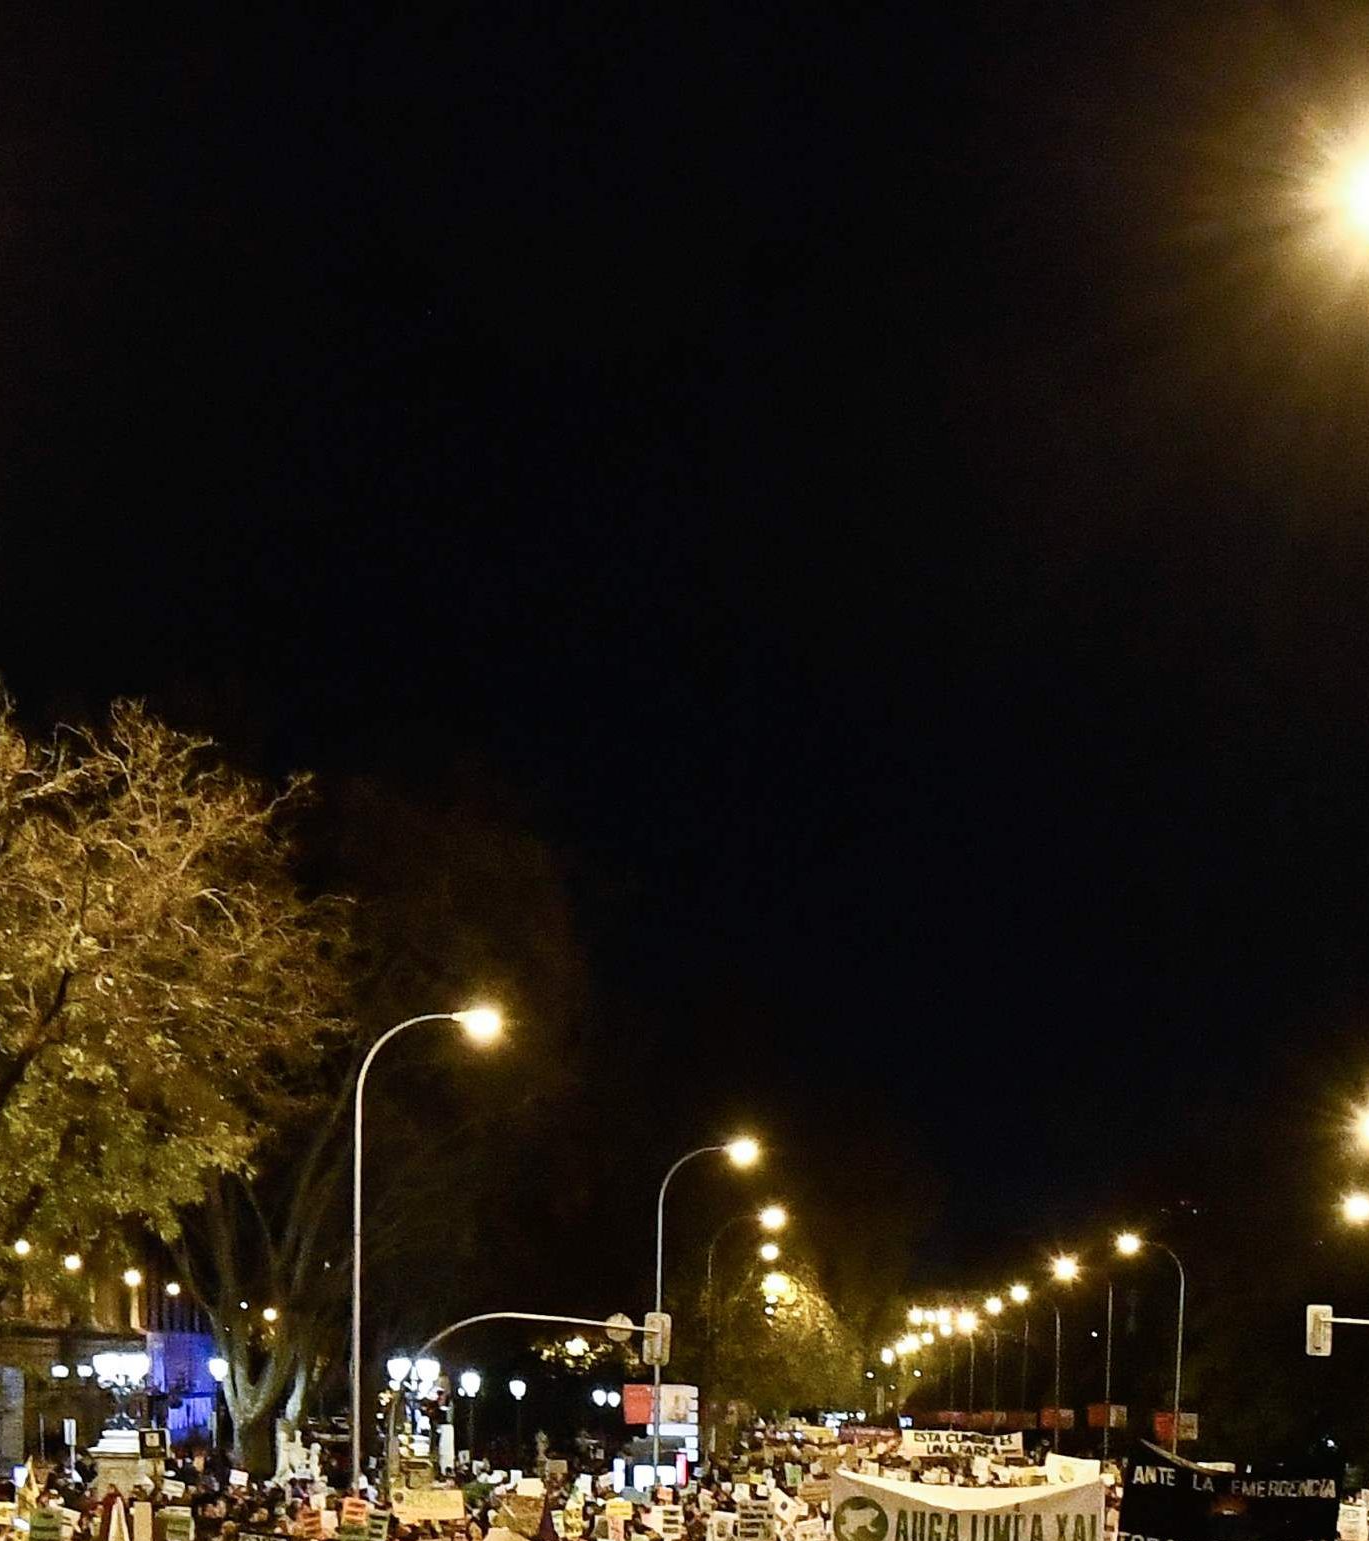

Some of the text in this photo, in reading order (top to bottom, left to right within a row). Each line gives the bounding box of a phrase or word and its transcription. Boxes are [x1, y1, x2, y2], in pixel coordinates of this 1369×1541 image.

[914, 1432, 941, 1443] ESTA
[927, 1444, 999, 1456] UNA FARSA
[1132, 1466, 1336, 1498] ANTE LA EMERGENCIA
